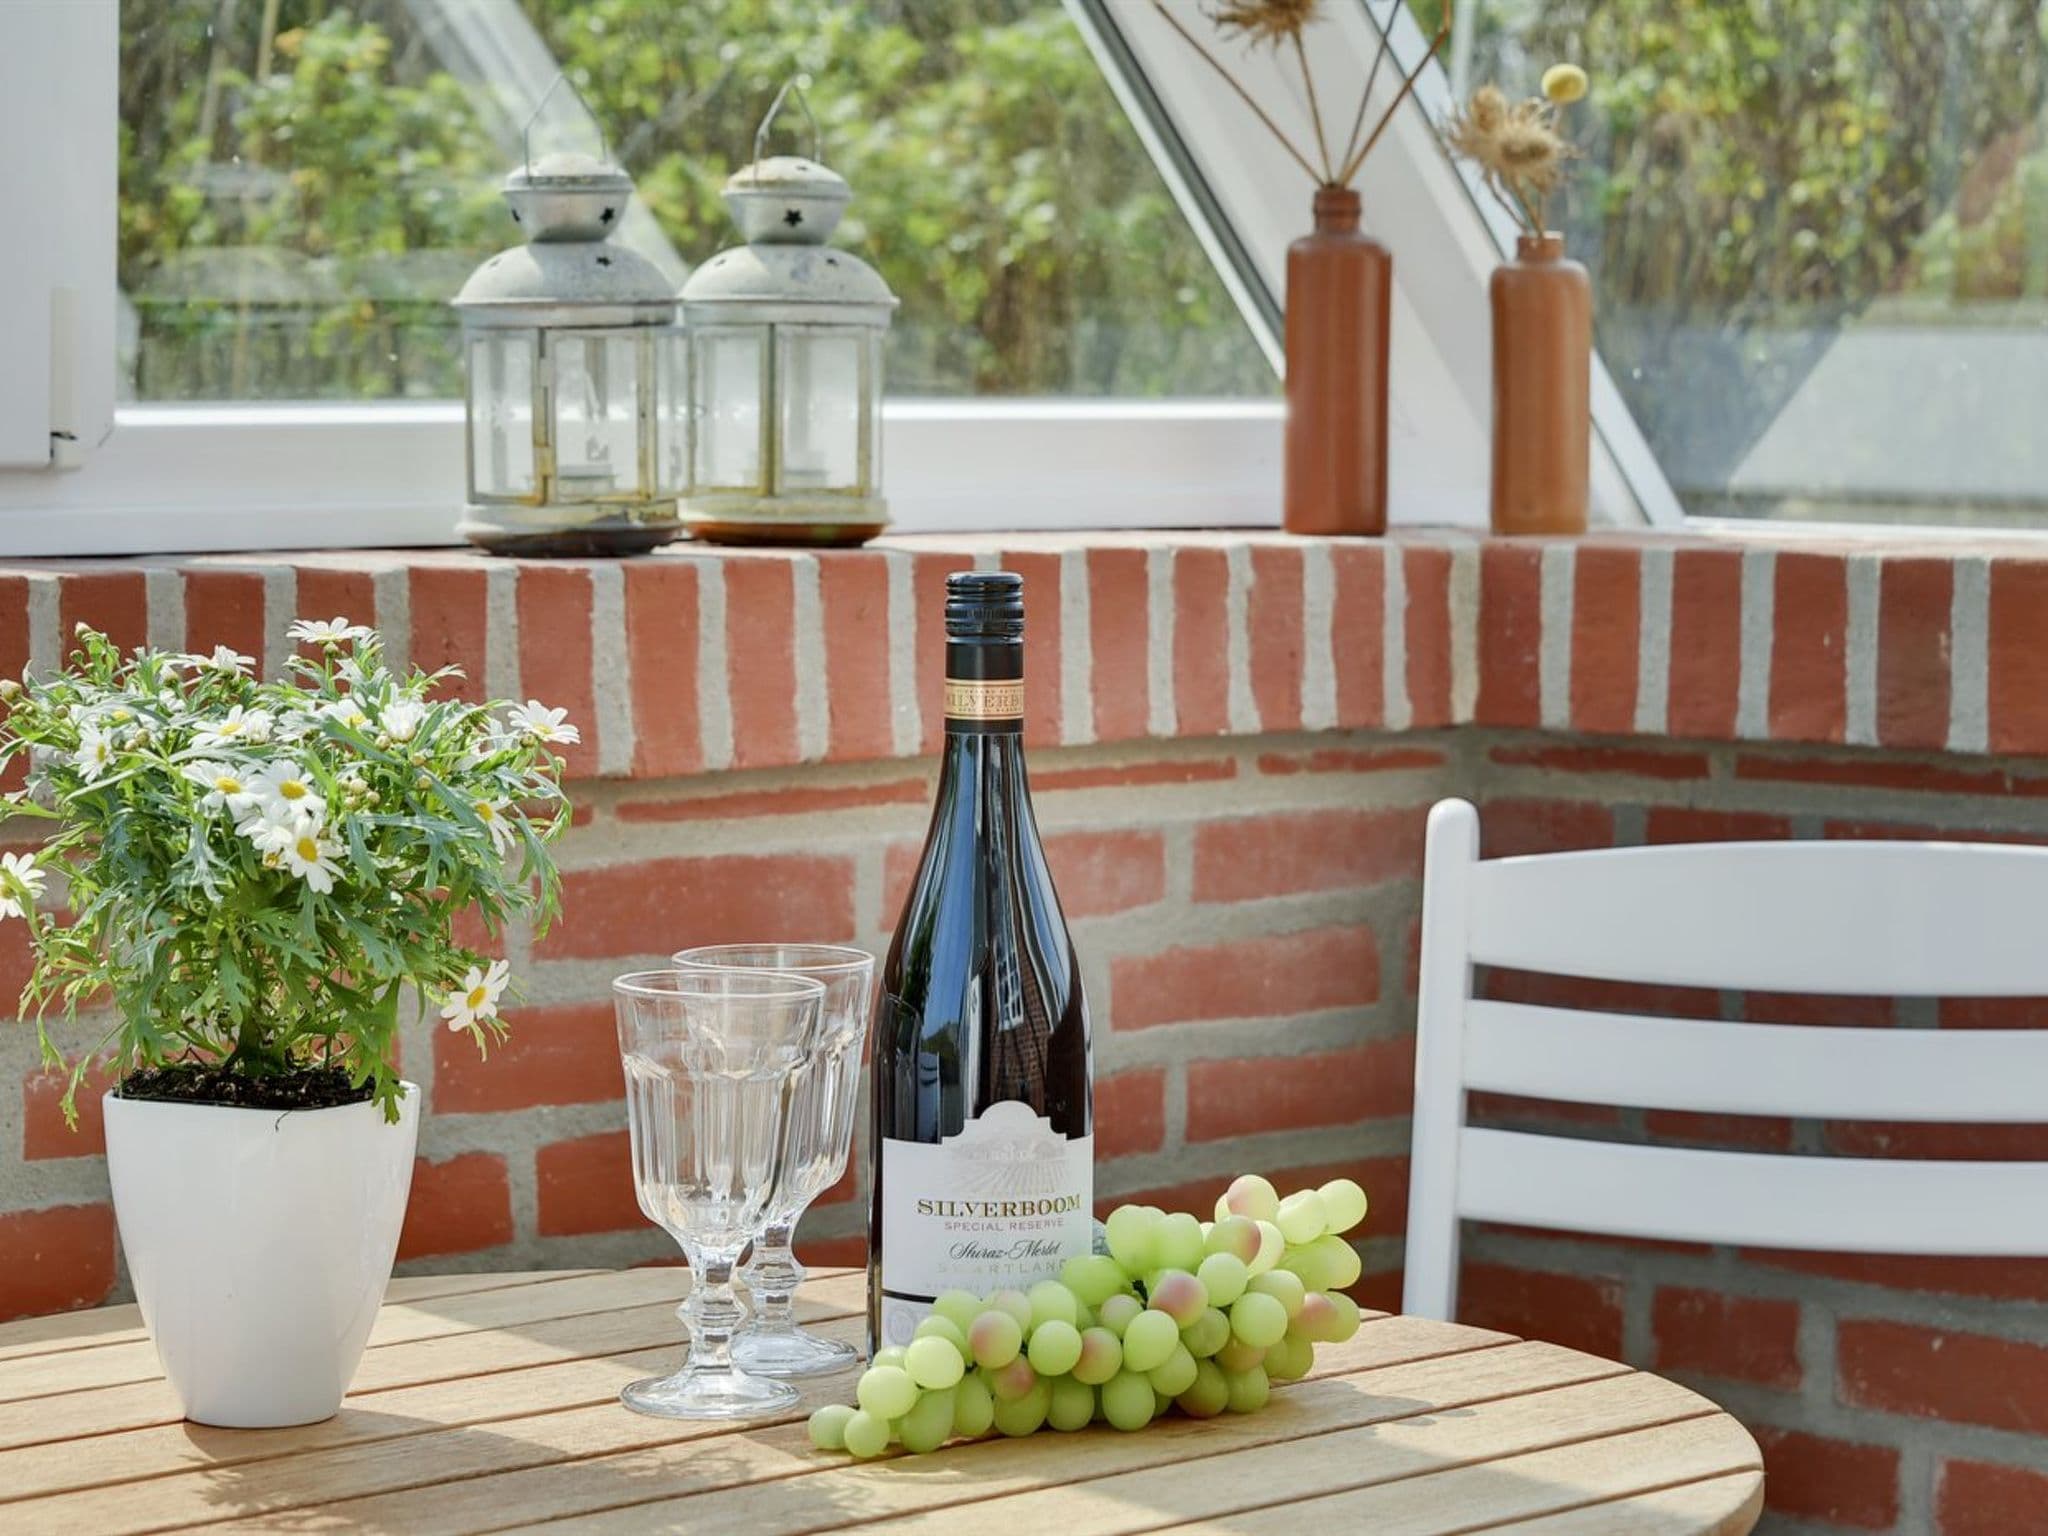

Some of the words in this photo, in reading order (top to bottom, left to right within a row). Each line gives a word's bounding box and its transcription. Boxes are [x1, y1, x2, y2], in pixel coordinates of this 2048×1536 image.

[917, 1195, 1081, 1218] SILVERBOOM
[944, 1221, 1003, 1232] SPECIAL
[1009, 1218, 1064, 1231] RESERVE
